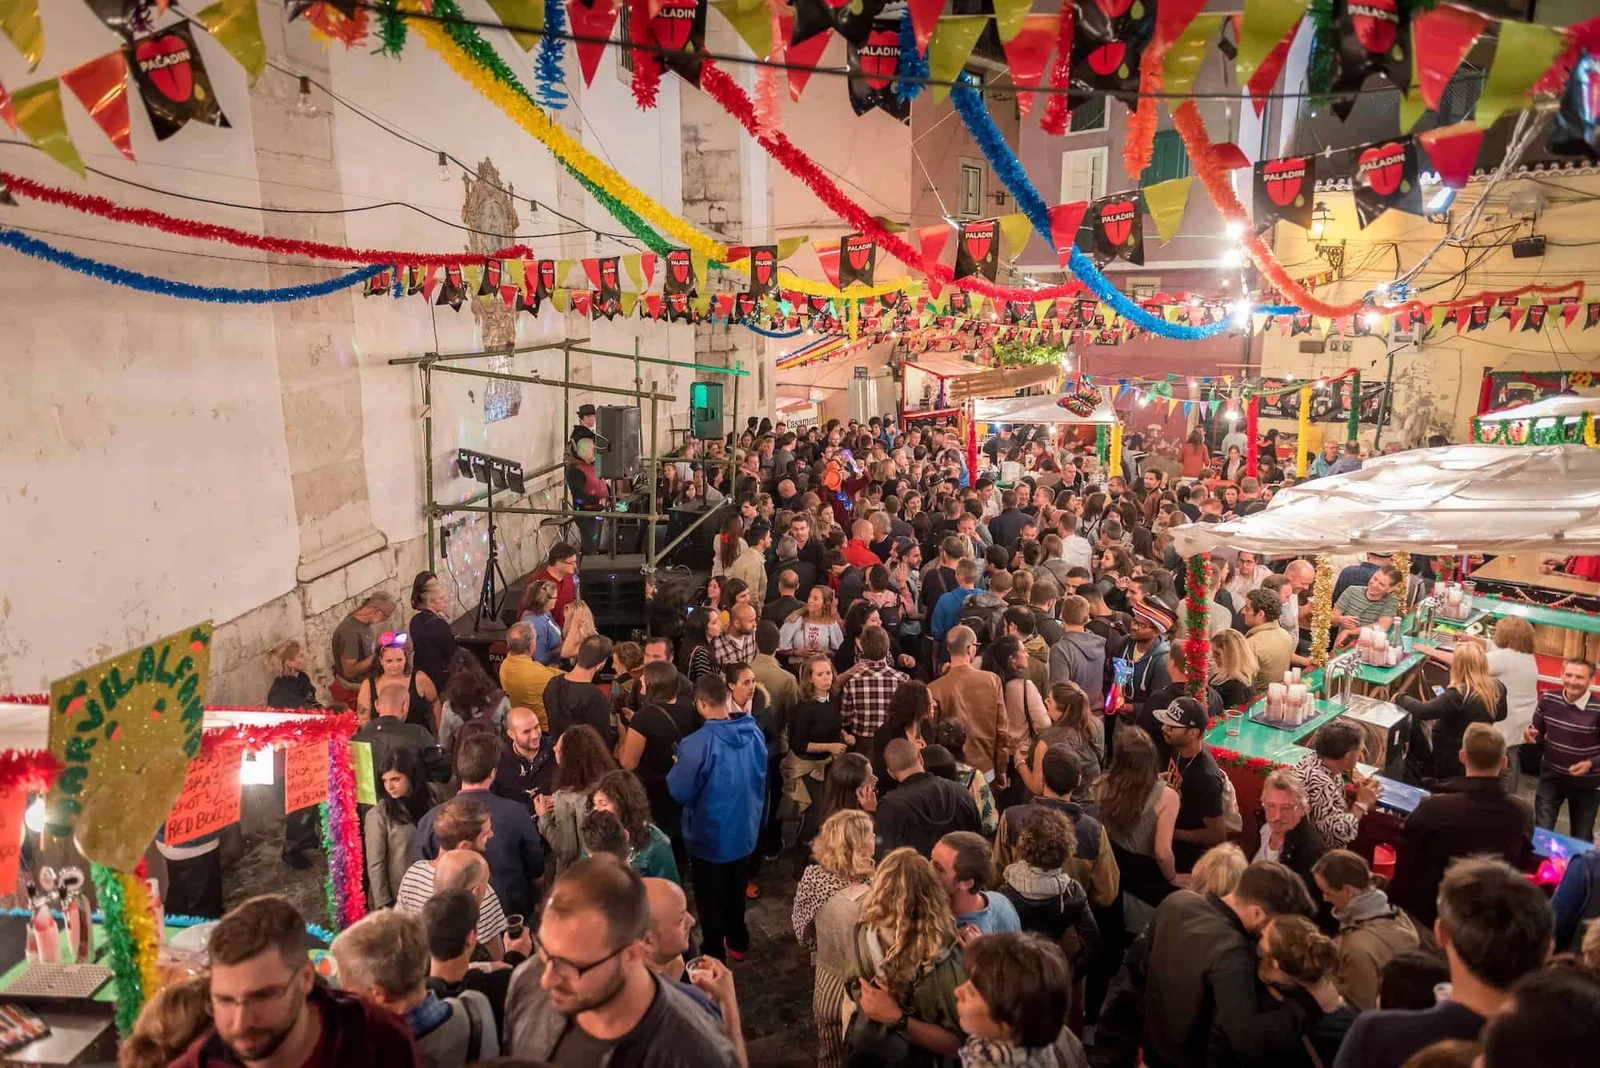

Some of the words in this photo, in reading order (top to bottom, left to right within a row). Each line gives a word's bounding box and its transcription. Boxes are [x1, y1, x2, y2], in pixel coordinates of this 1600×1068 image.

[659, 8, 696, 18] LADIN
[140, 50, 191, 72] PALADIN
[1359, 153, 1406, 173] PALADIN
[1263, 169, 1305, 182] PALADIN
[1101, 212, 1135, 224] PALADIN
[965, 231, 994, 239] PALADIN
[847, 243, 873, 252] PALADIN
[168, 818, 194, 839] RED
